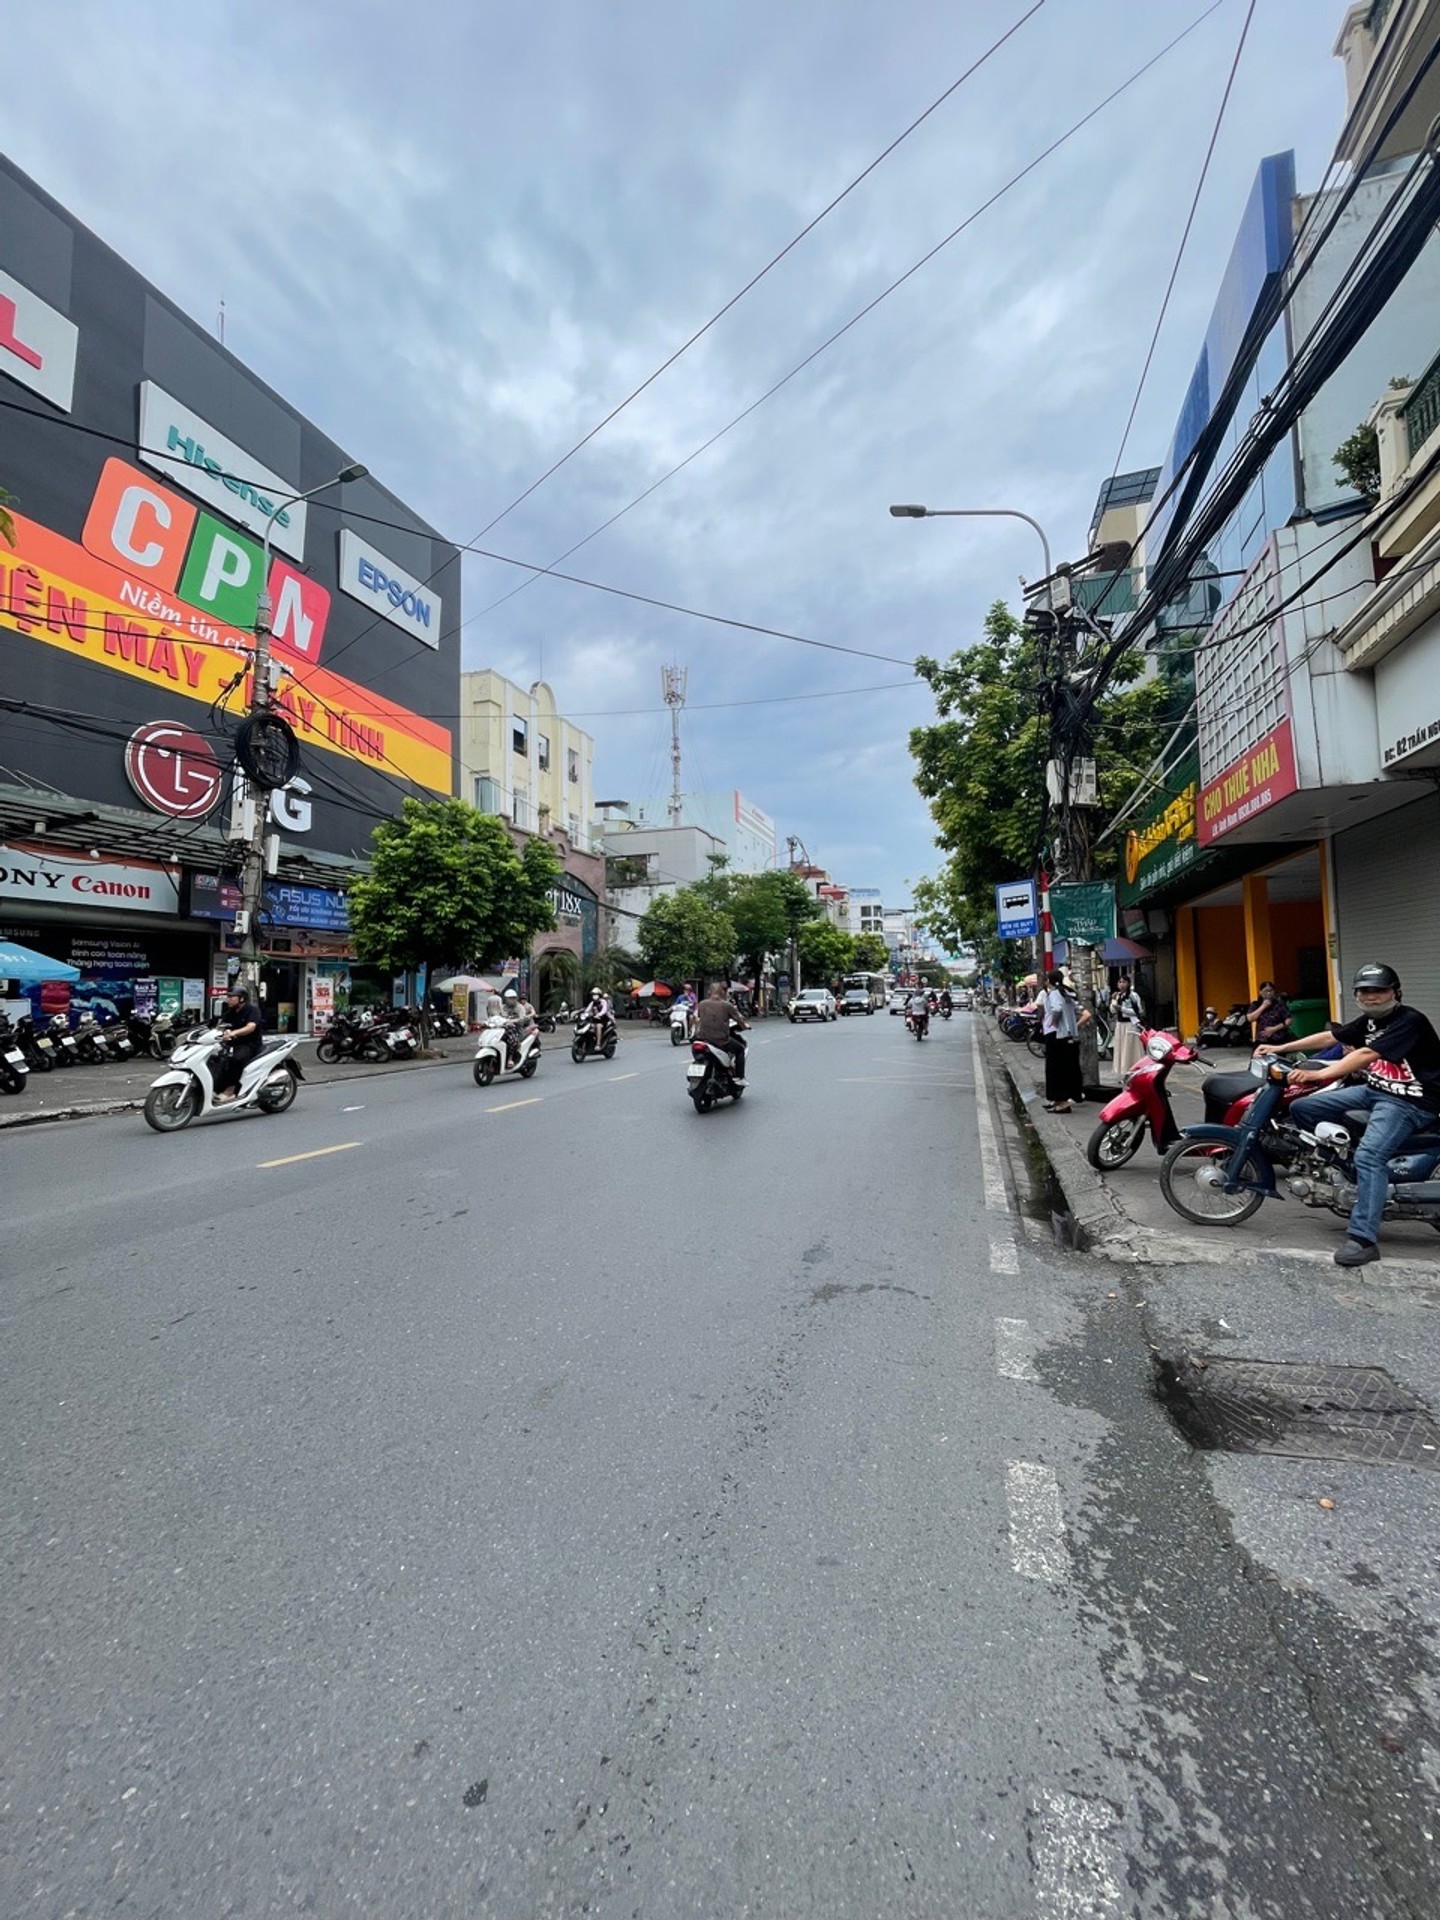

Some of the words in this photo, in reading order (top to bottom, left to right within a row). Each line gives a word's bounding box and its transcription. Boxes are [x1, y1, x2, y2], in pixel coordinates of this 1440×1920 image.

[167, 425, 290, 529] Hisense
[119, 581, 182, 627] Niềm
[190, 615, 220, 643] tin
[359, 557, 430, 628] EPSON
[104, 611, 207, 689] MÁY
[324, 709, 385, 762] TÍNH
[1204, 787, 1222, 821] CHO
[1223, 759, 1250, 807] THUÊ
[71, 876, 150, 899] Canon
[279, 888, 321, 905] ASUS
[71, 938, 109, 949] Samsung
